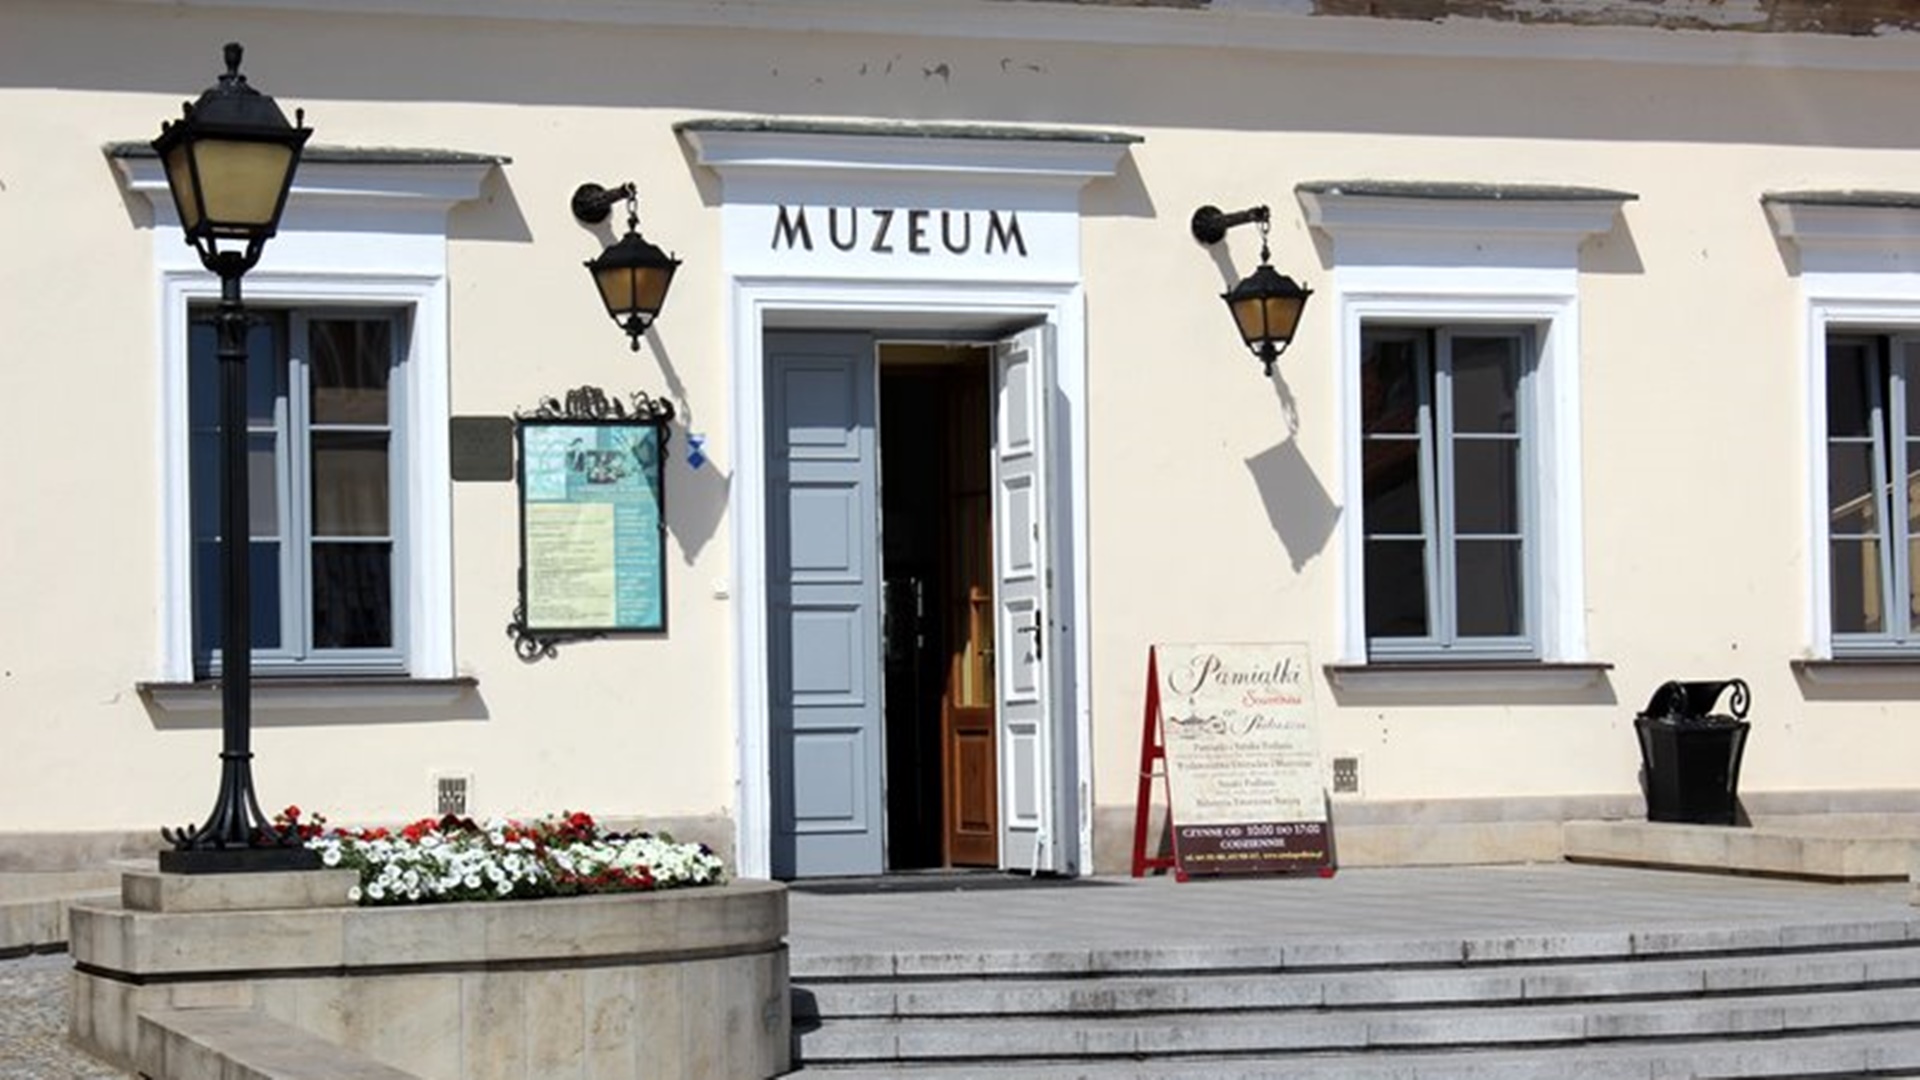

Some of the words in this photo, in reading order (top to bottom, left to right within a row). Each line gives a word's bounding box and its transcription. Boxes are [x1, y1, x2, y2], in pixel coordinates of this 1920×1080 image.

[771, 204, 1027, 257] MUZEUM
[1182, 827, 1223, 838] CZYNNE
[1224, 827, 1242, 836] OD
[1276, 825, 1293, 835] DO
[1294, 823, 1320, 834] 17:00
[1220, 838, 1285, 849] CODZIENNIE
